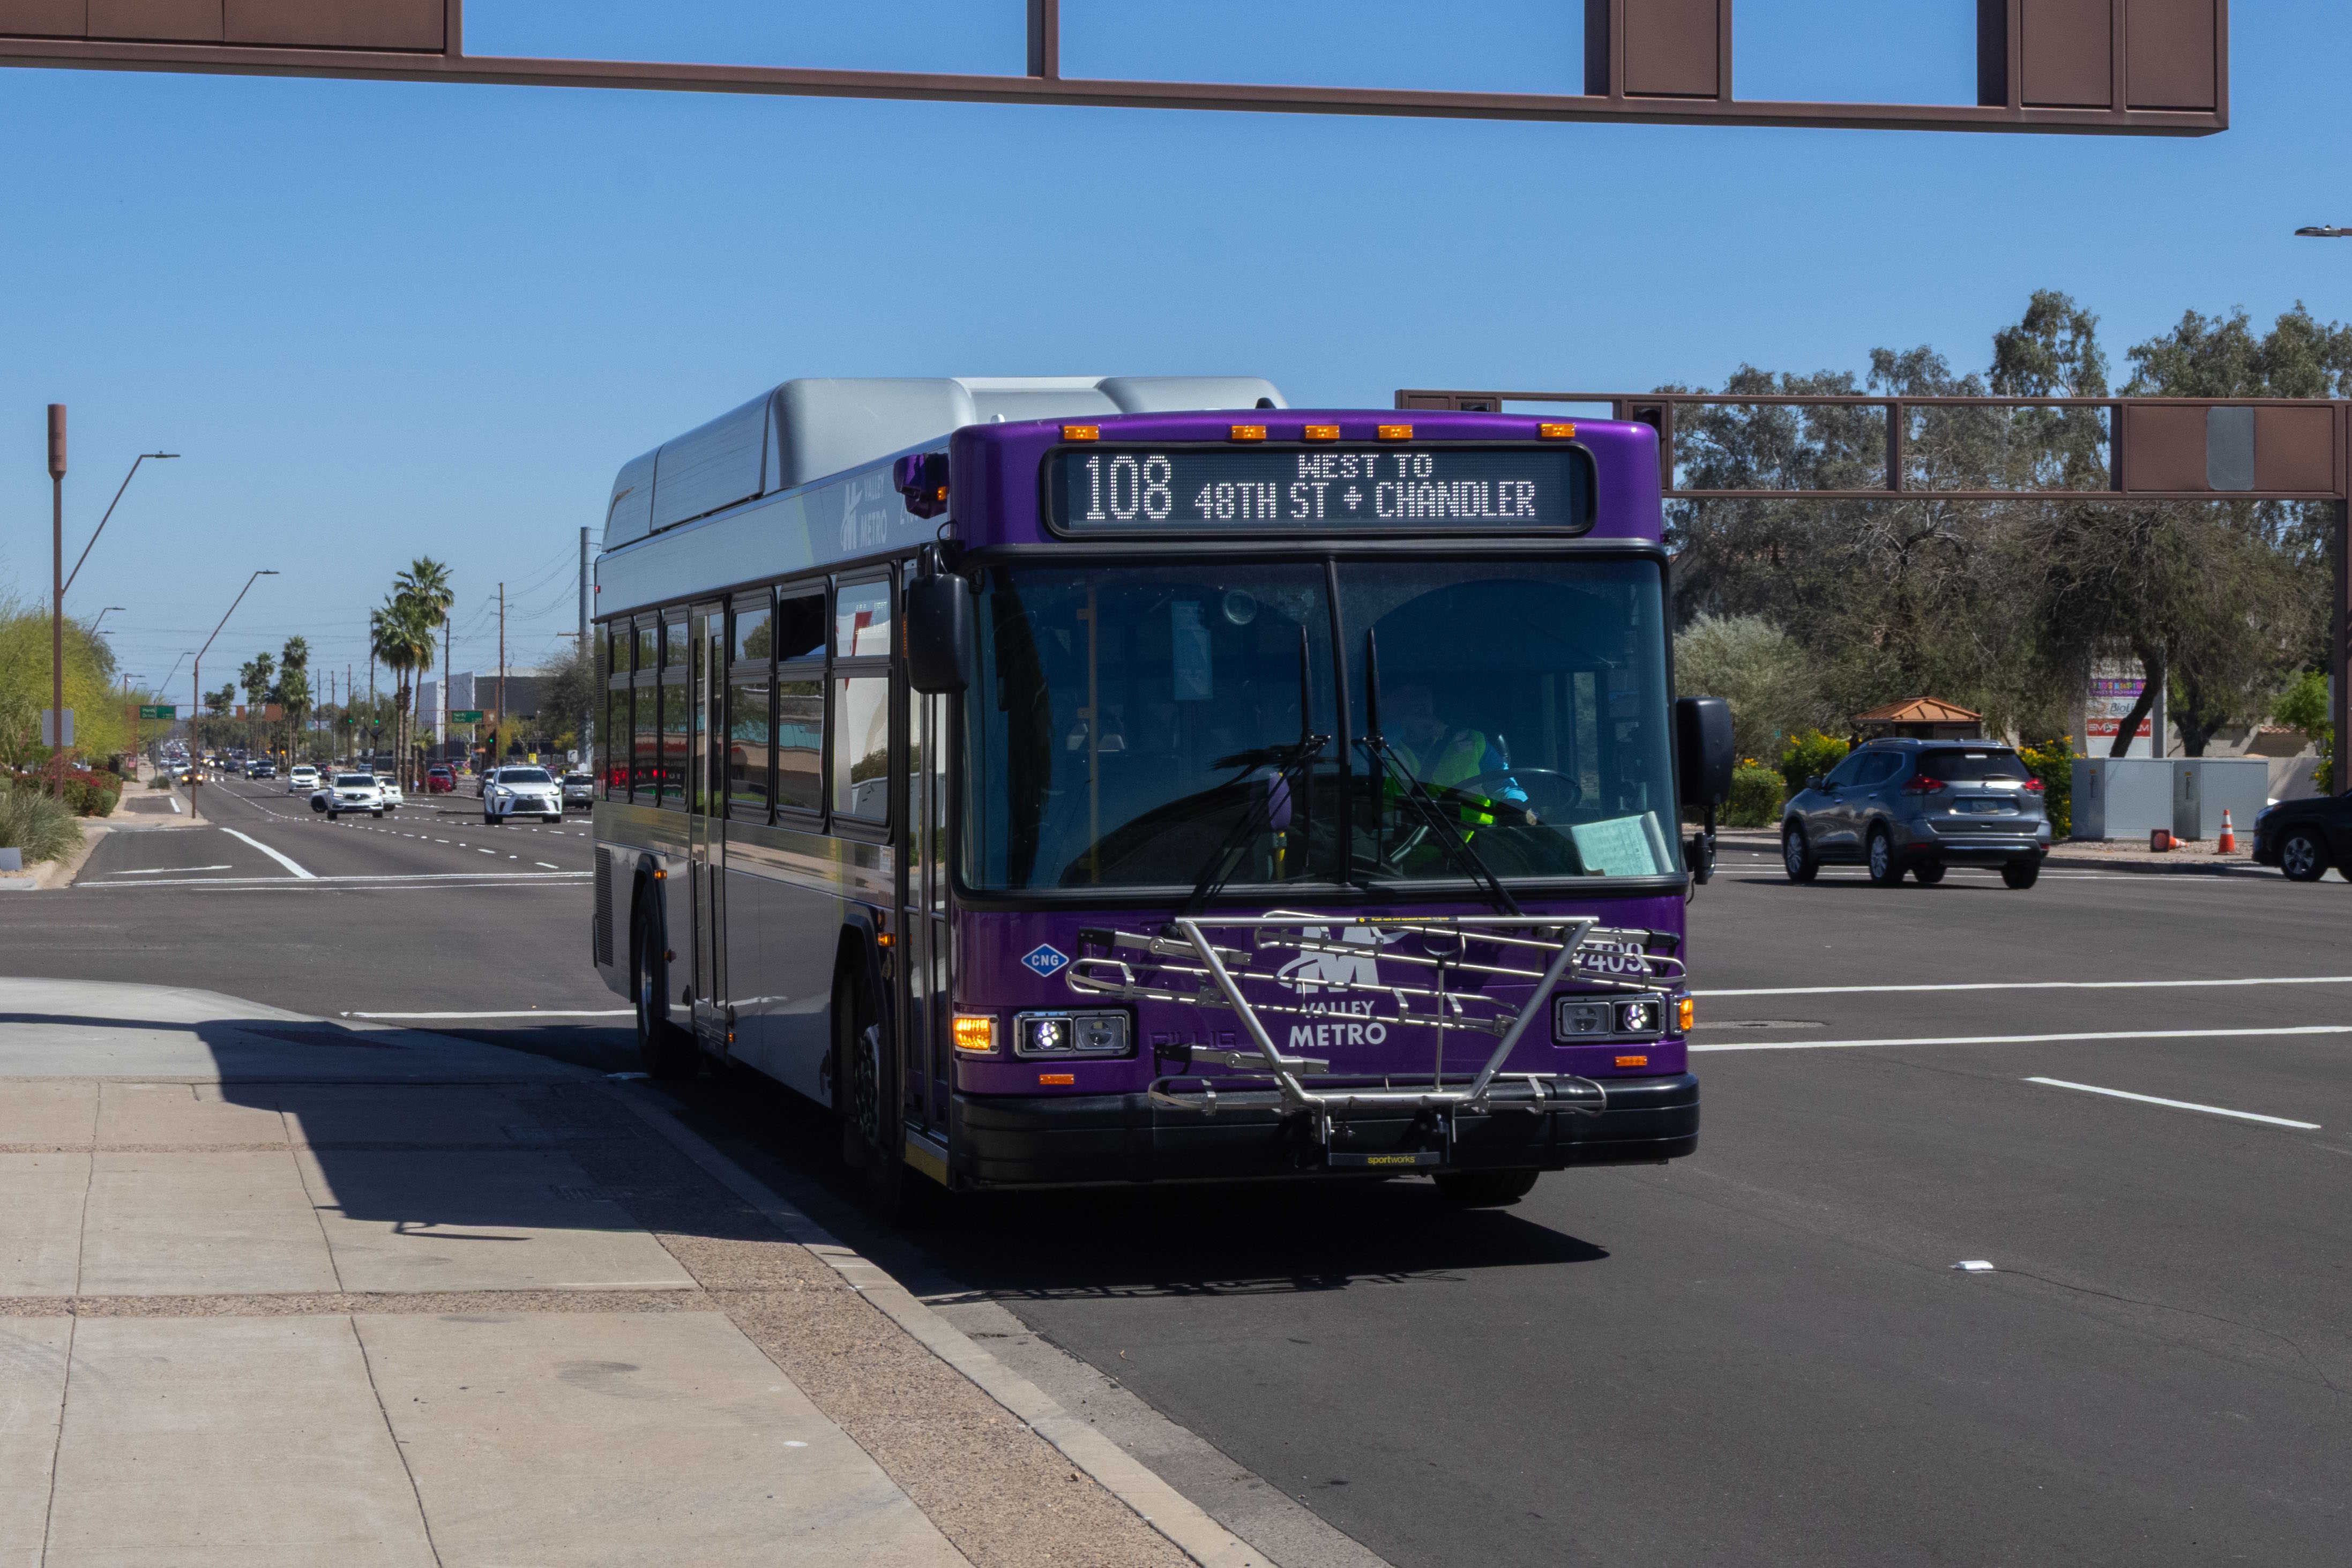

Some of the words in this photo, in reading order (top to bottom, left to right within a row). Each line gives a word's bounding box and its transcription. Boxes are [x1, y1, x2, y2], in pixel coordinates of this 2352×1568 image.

[1298, 454, 1379, 478] WEST
[1393, 454, 1432, 477] TO
[1086, 455, 1172, 520] 108
[1194, 482, 1276, 519] 48TH
[1290, 482, 1330, 518] ST
[1376, 481, 1536, 518] CHANDLER
[2110, 702, 2135, 713] BioLi
[1031, 954, 1059, 966] CNG
[1302, 1000, 1375, 1018] VALLEY
[1288, 1022, 1387, 1047] METRO
[1367, 1155, 1416, 1165] sportworks
